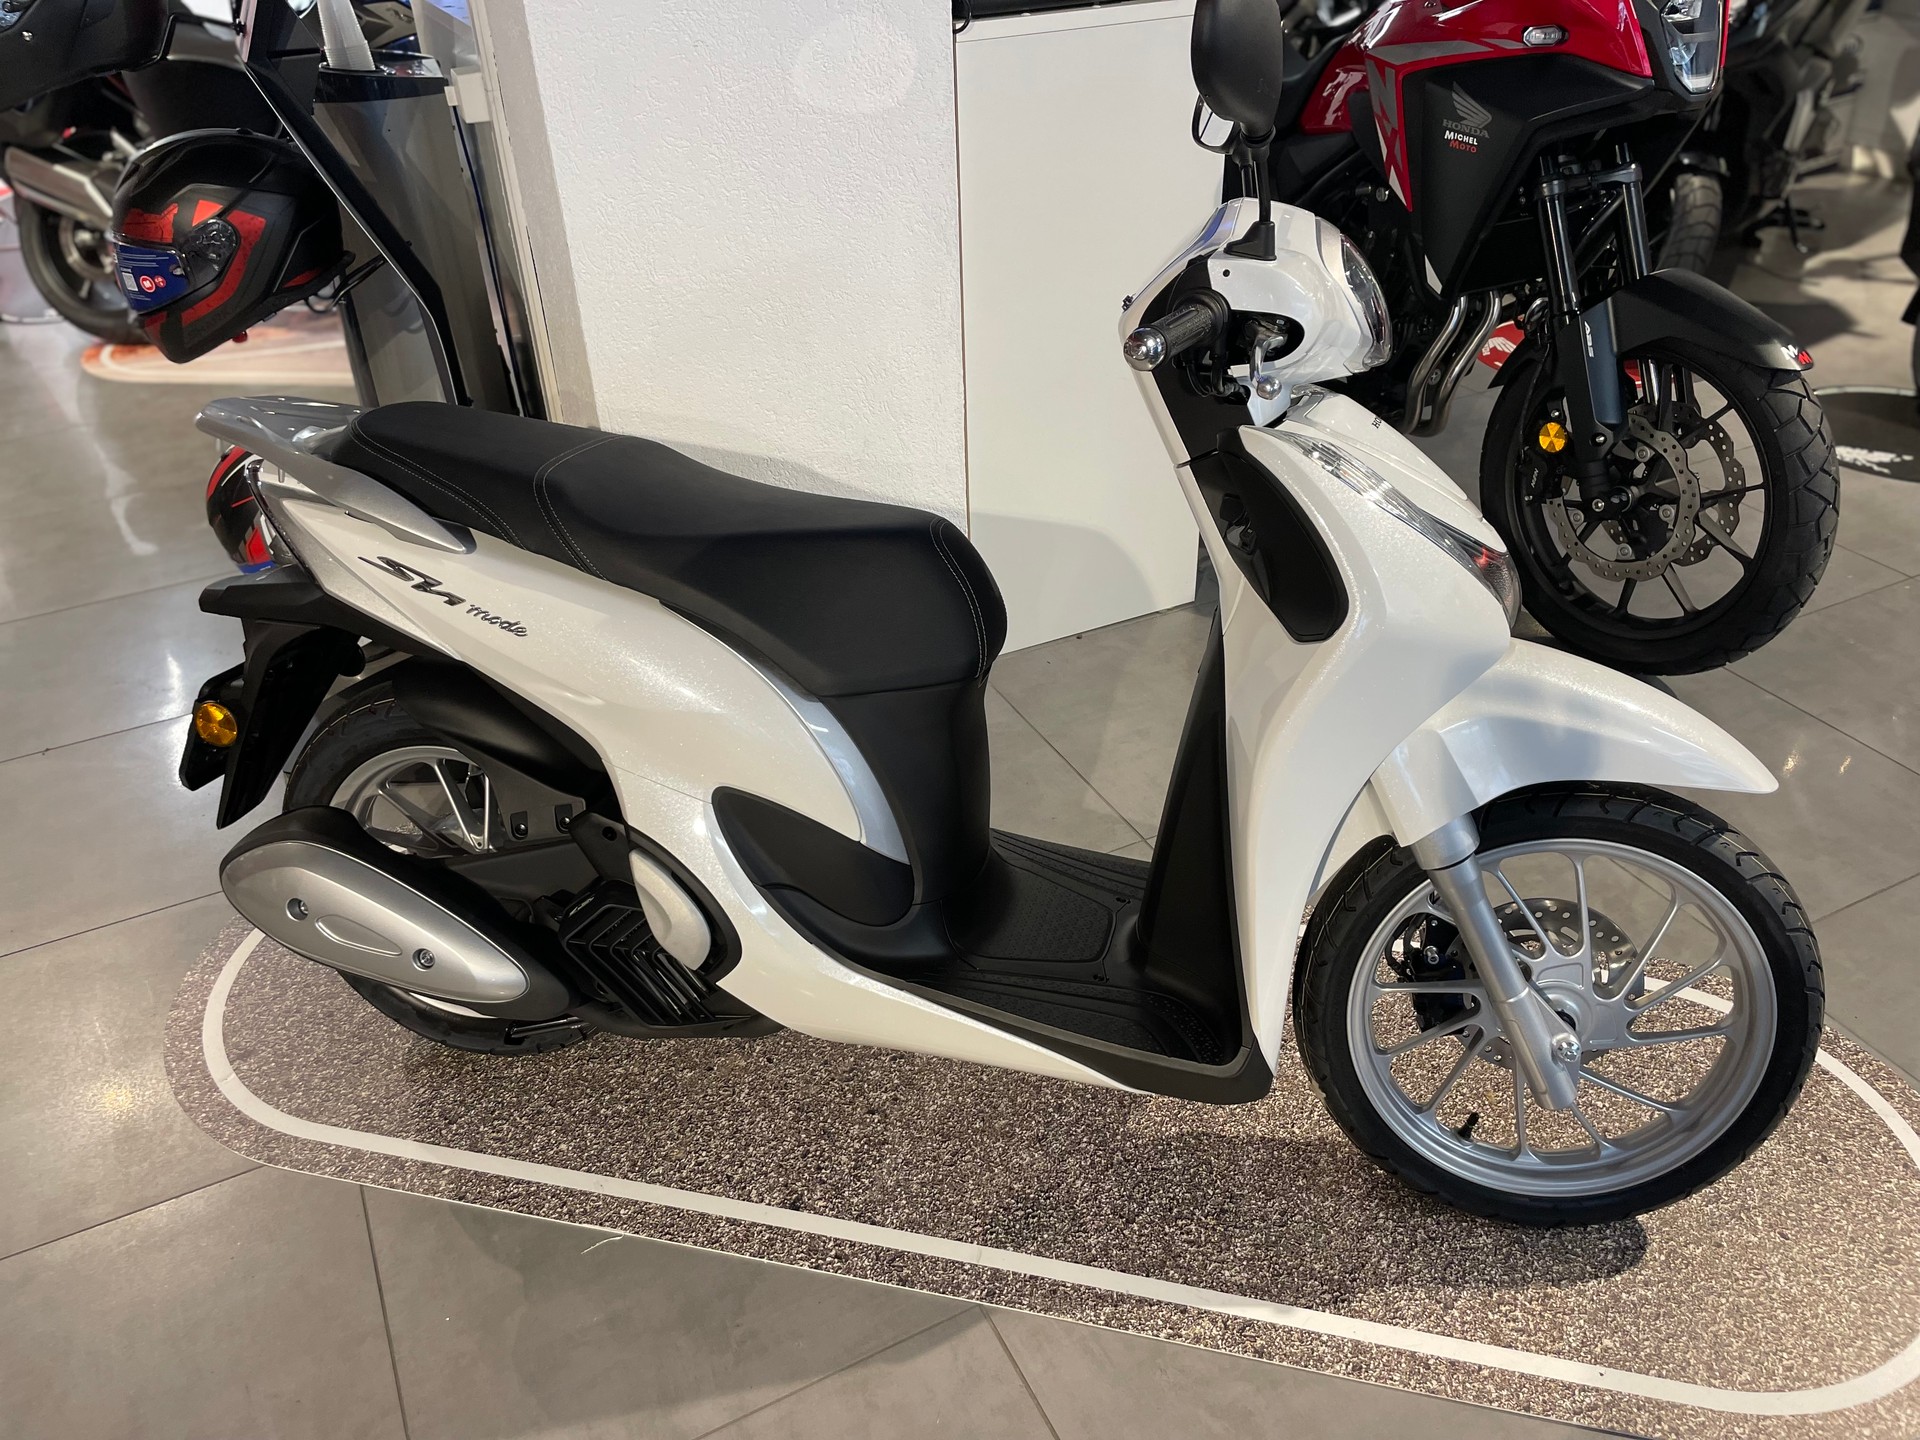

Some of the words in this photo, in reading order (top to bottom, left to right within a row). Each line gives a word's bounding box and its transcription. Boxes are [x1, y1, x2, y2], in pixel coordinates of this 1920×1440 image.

[1442, 118, 1490, 138] HONDA
[1444, 130, 1478, 145] MICHEL
[1450, 141, 1477, 153] MOTO
[466, 604, 528, 637] mode
